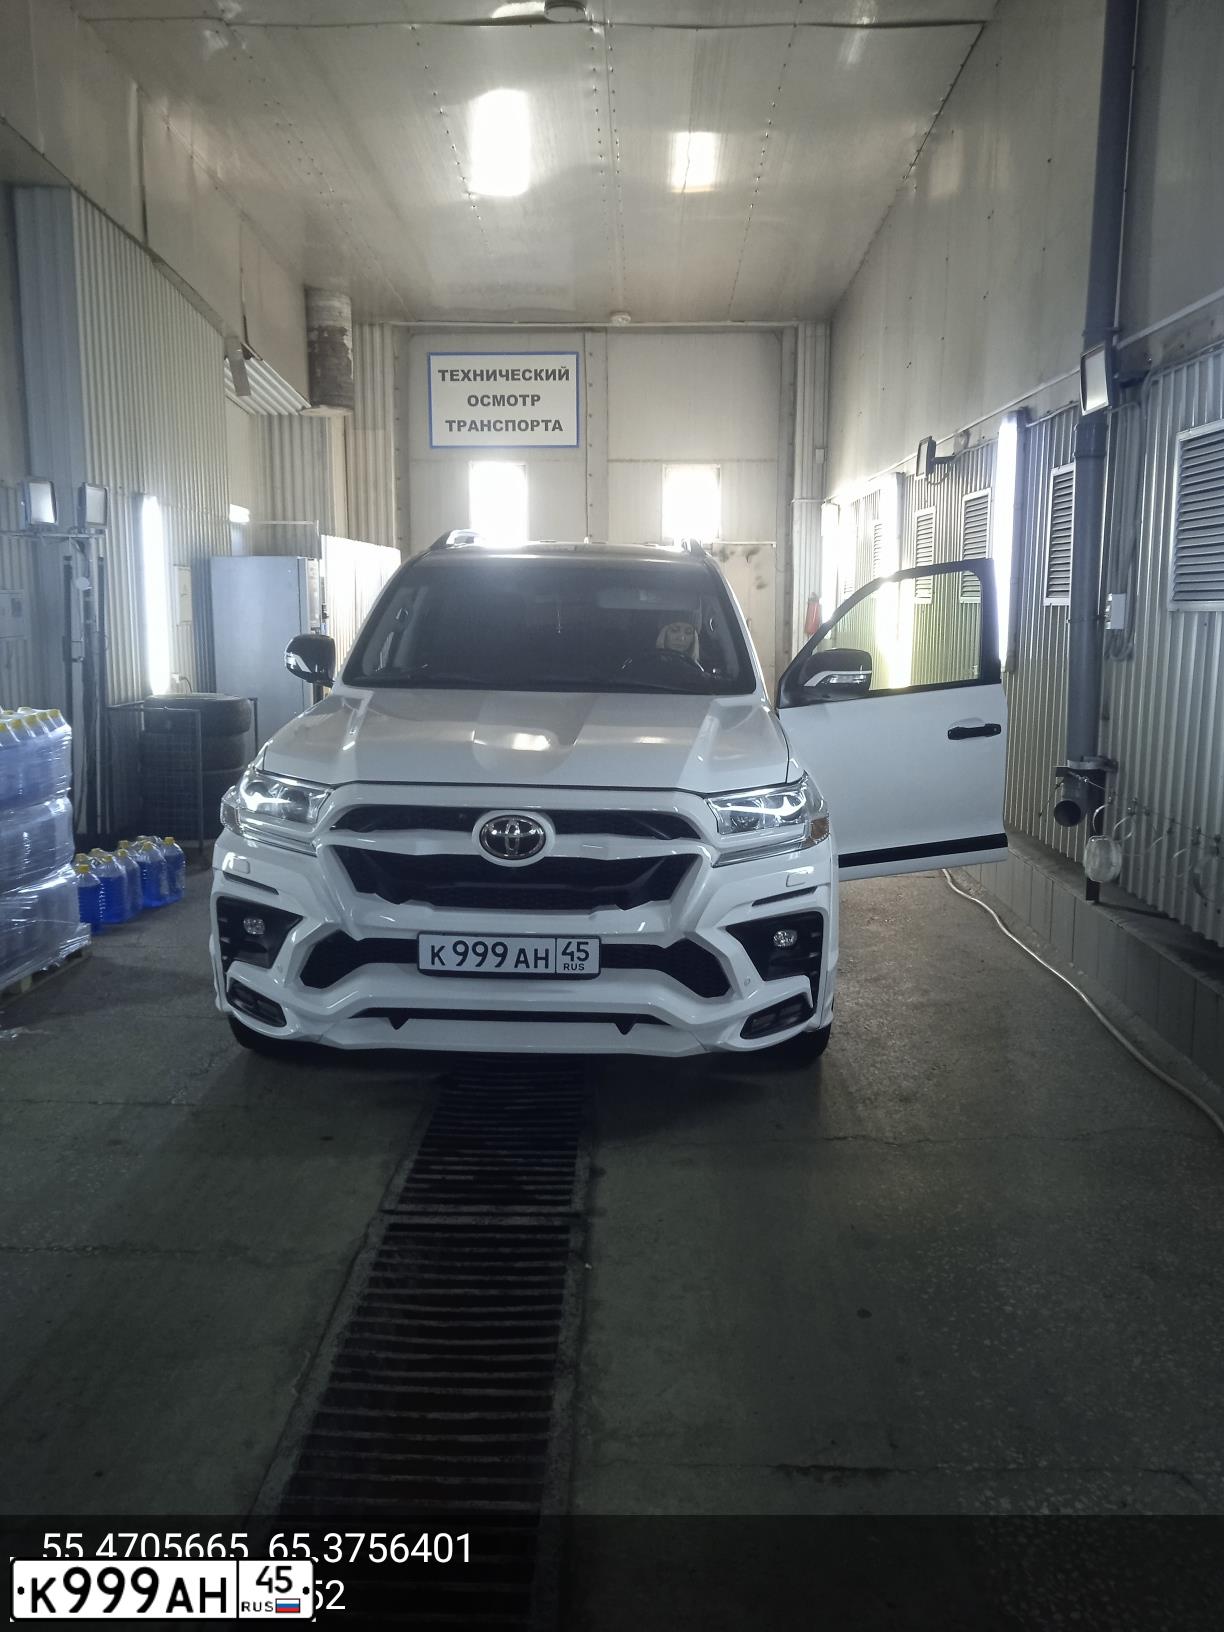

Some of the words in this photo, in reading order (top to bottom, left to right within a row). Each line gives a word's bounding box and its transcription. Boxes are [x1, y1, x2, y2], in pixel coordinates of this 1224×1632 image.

[438, 366, 570, 382] ТЕХНИЧЕСКИЙ
[467, 394, 541, 407] ОСМОТР
[445, 419, 563, 432] ТРАНСПОРТА
[561, 941, 590, 962] 45
[563, 962, 585, 971] RUS
